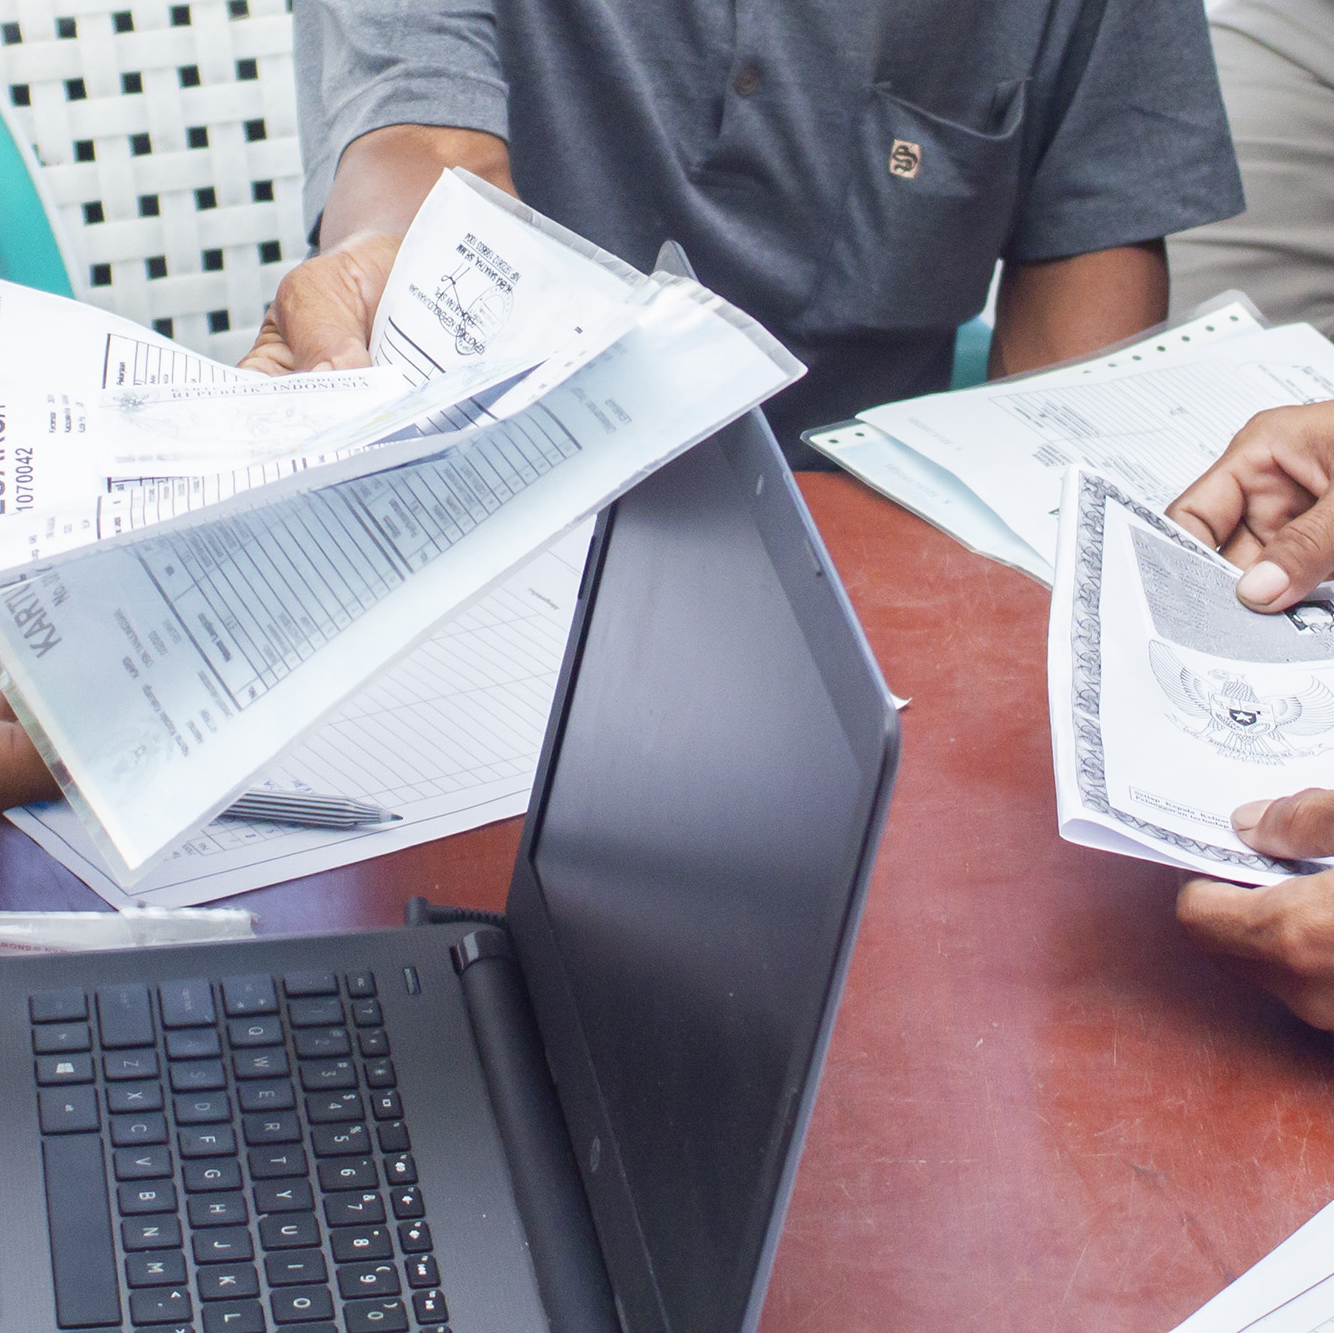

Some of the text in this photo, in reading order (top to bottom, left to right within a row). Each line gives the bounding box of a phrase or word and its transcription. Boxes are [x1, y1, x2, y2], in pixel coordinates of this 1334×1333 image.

[205, 1170, 220, 1178] G
[220, 1277, 235, 1285] K
[281, 1226, 296, 1234] U
[144, 1228, 157, 1236] N
[148, 1263, 163, 1272] M
